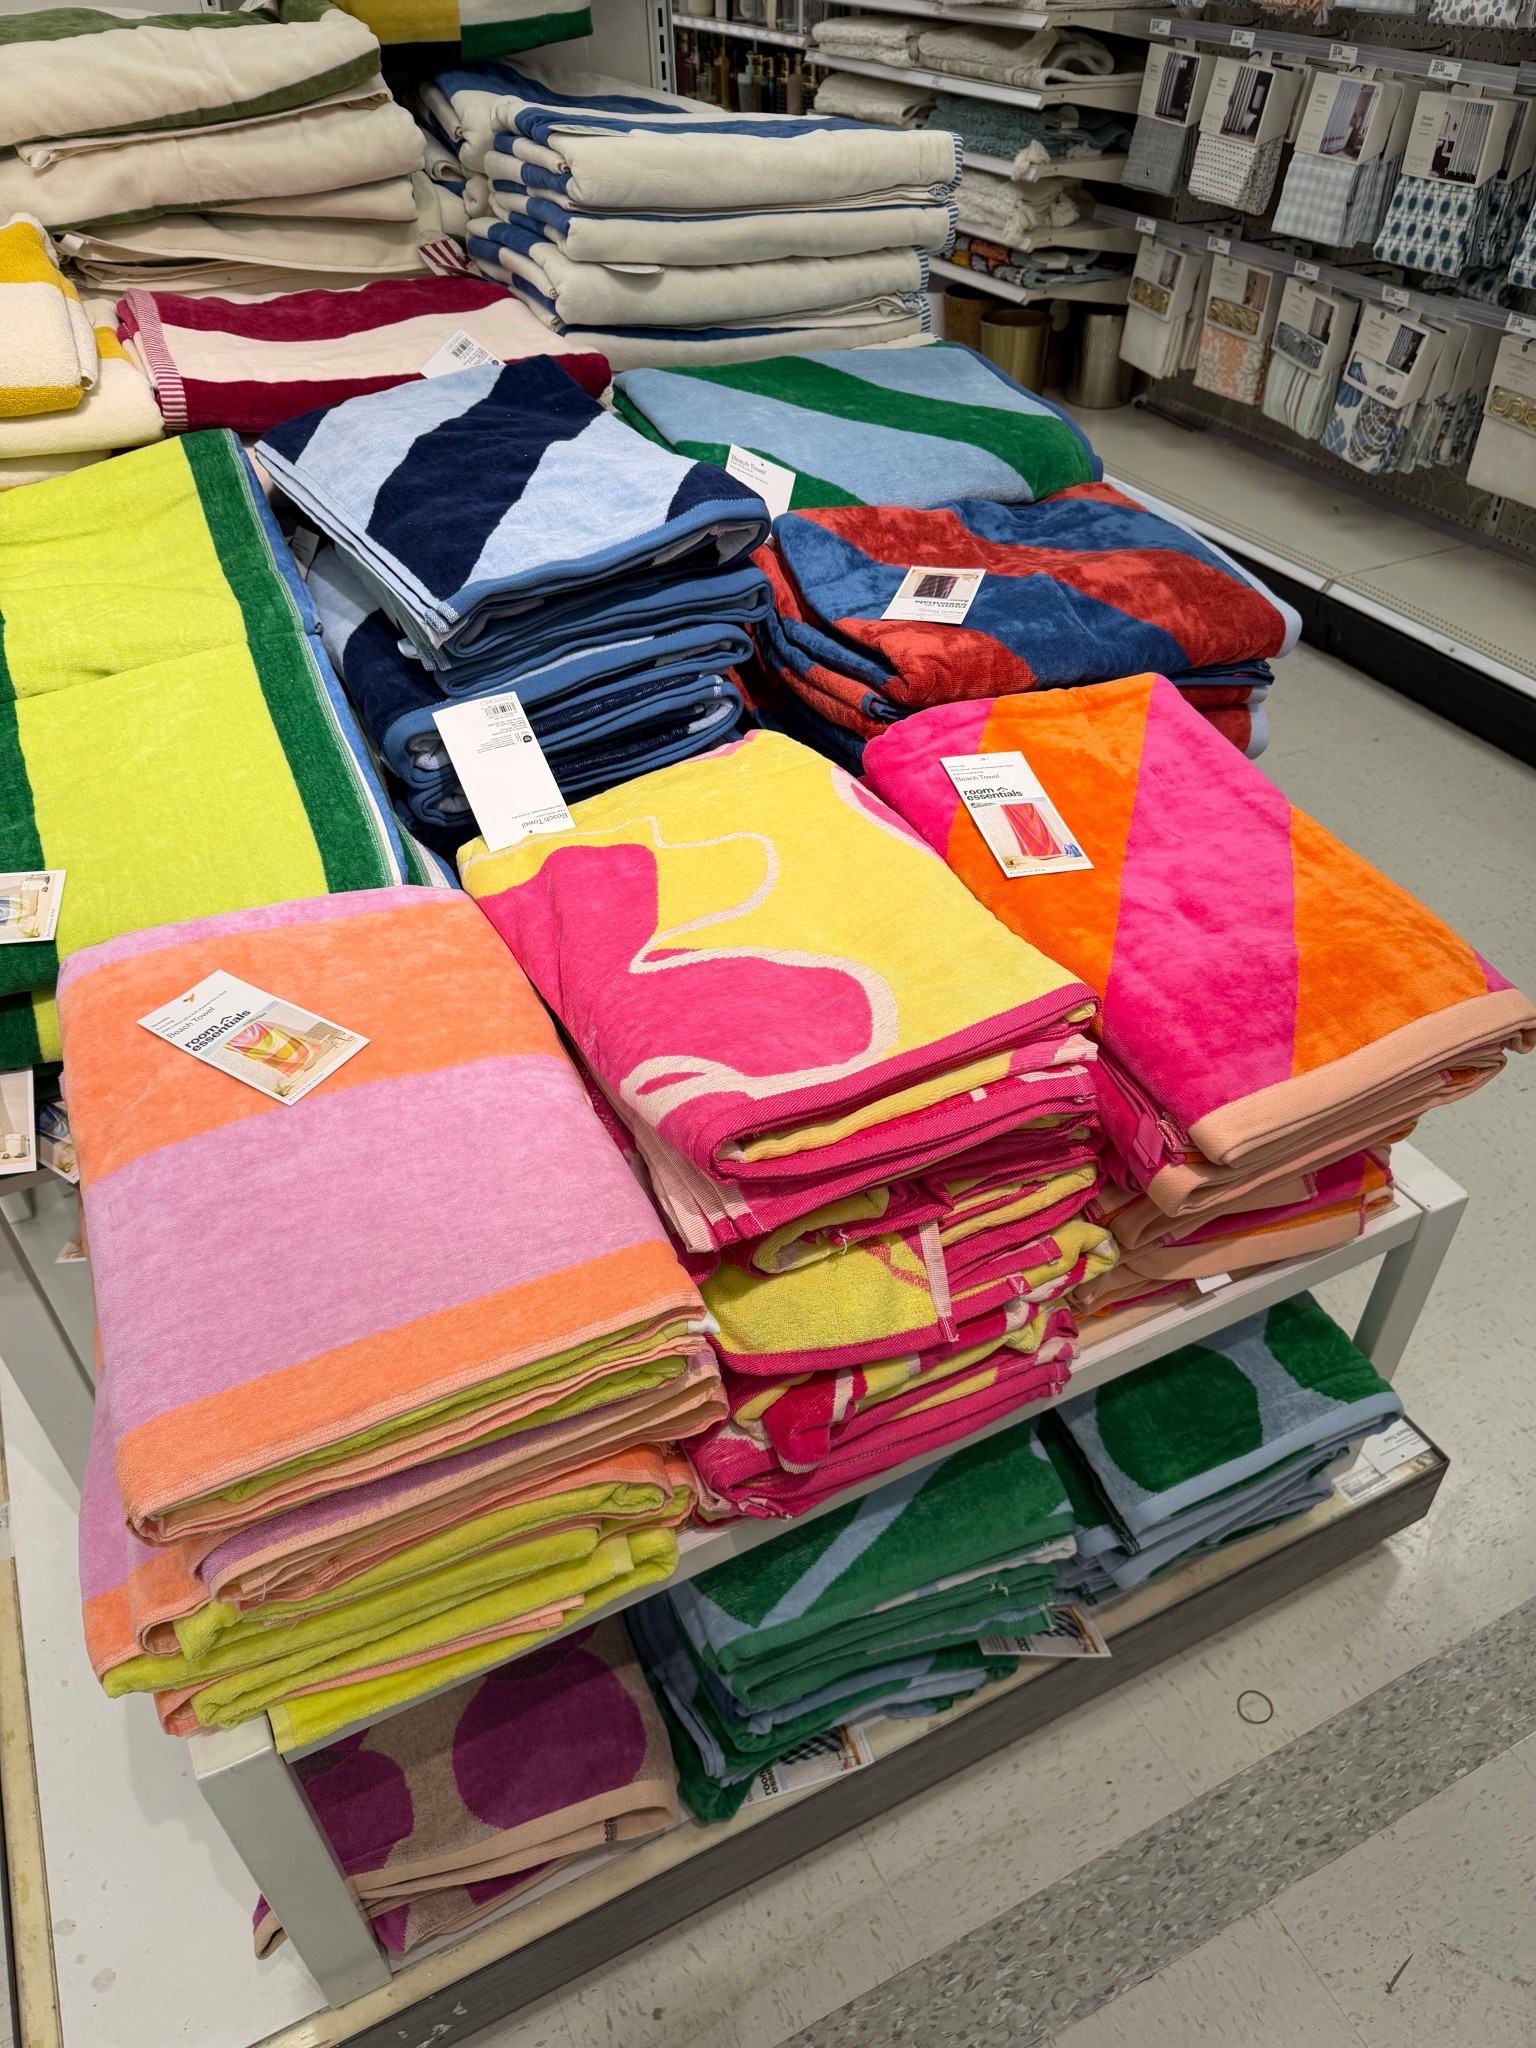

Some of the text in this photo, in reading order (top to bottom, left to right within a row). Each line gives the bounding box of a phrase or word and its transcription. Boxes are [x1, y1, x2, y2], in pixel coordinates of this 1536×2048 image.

[731, 454, 750, 467] Beach
[750, 463, 767, 475] Towel
[966, 790, 1023, 801] essentials
[521, 818, 544, 829] Towel
[543, 812, 568, 822] Beach
[166, 1022, 194, 1039] Beach
[191, 1006, 216, 1022] Towel
[192, 1010, 251, 1052] essentials
[184, 1025, 220, 1048] room
